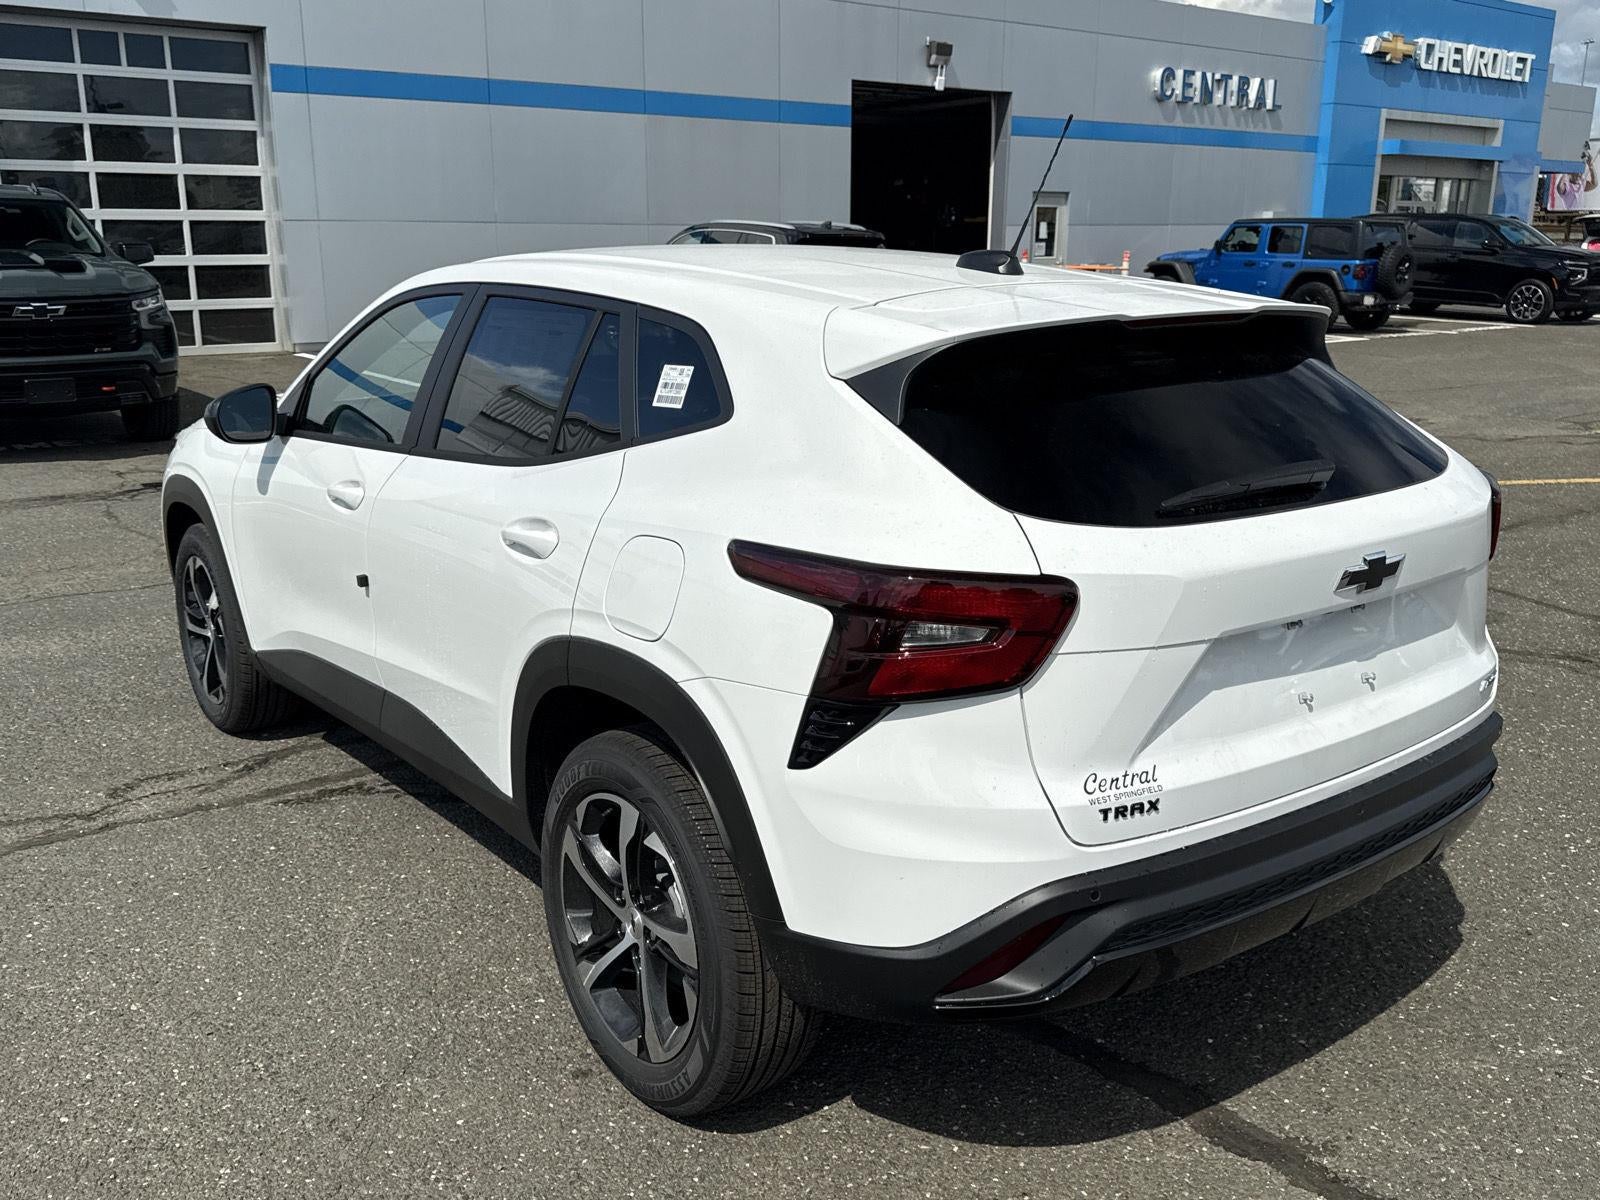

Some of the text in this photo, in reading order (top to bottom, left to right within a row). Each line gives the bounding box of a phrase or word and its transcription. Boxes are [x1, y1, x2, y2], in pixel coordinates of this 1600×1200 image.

[1415, 37, 1536, 82] CHEVROLET
[1155, 66, 1281, 111] CENTRAL
[1083, 764, 1158, 795] Central
[1088, 784, 1163, 806] WEST SPRINGFIELD
[1099, 798, 1160, 822] TRAX
